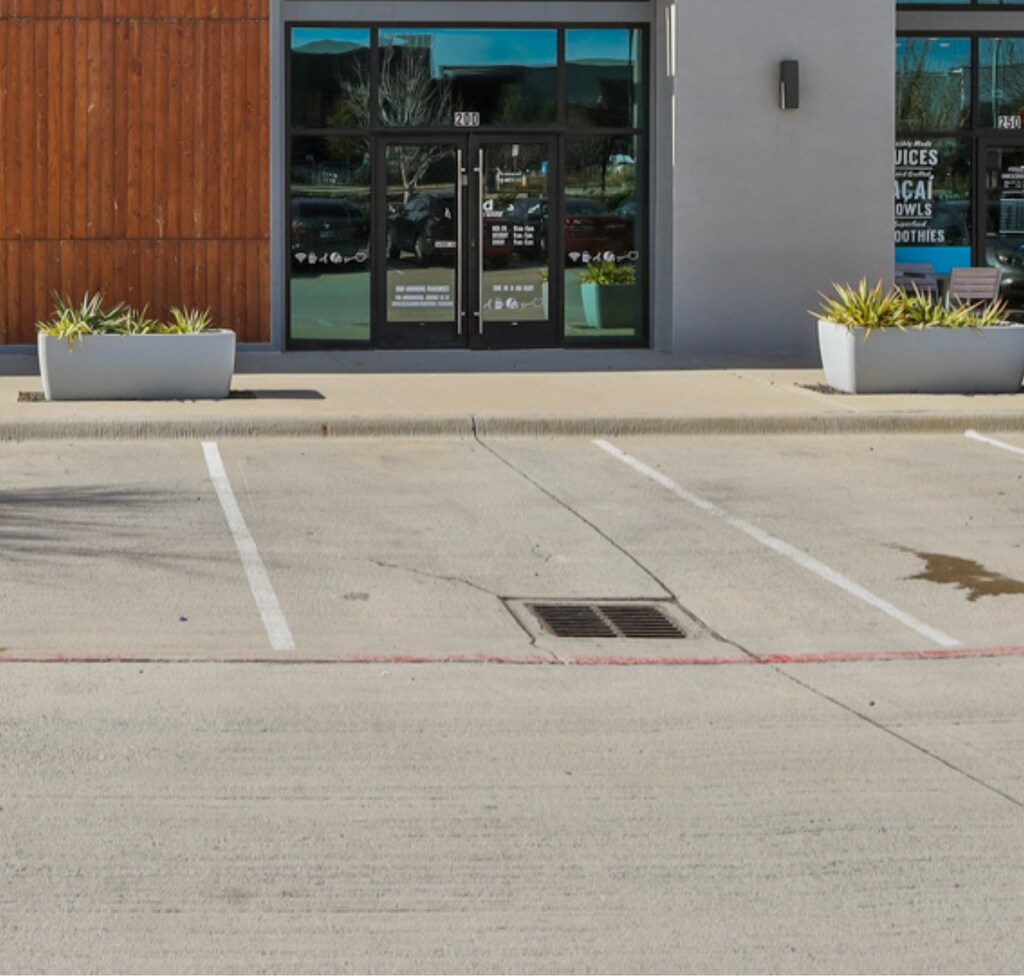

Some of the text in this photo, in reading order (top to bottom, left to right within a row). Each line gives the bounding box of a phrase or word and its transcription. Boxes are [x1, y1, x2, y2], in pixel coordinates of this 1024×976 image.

[455, 111, 480, 127] 200
[998, 115, 1021, 128] 250
[895, 203, 932, 215] OWLS
